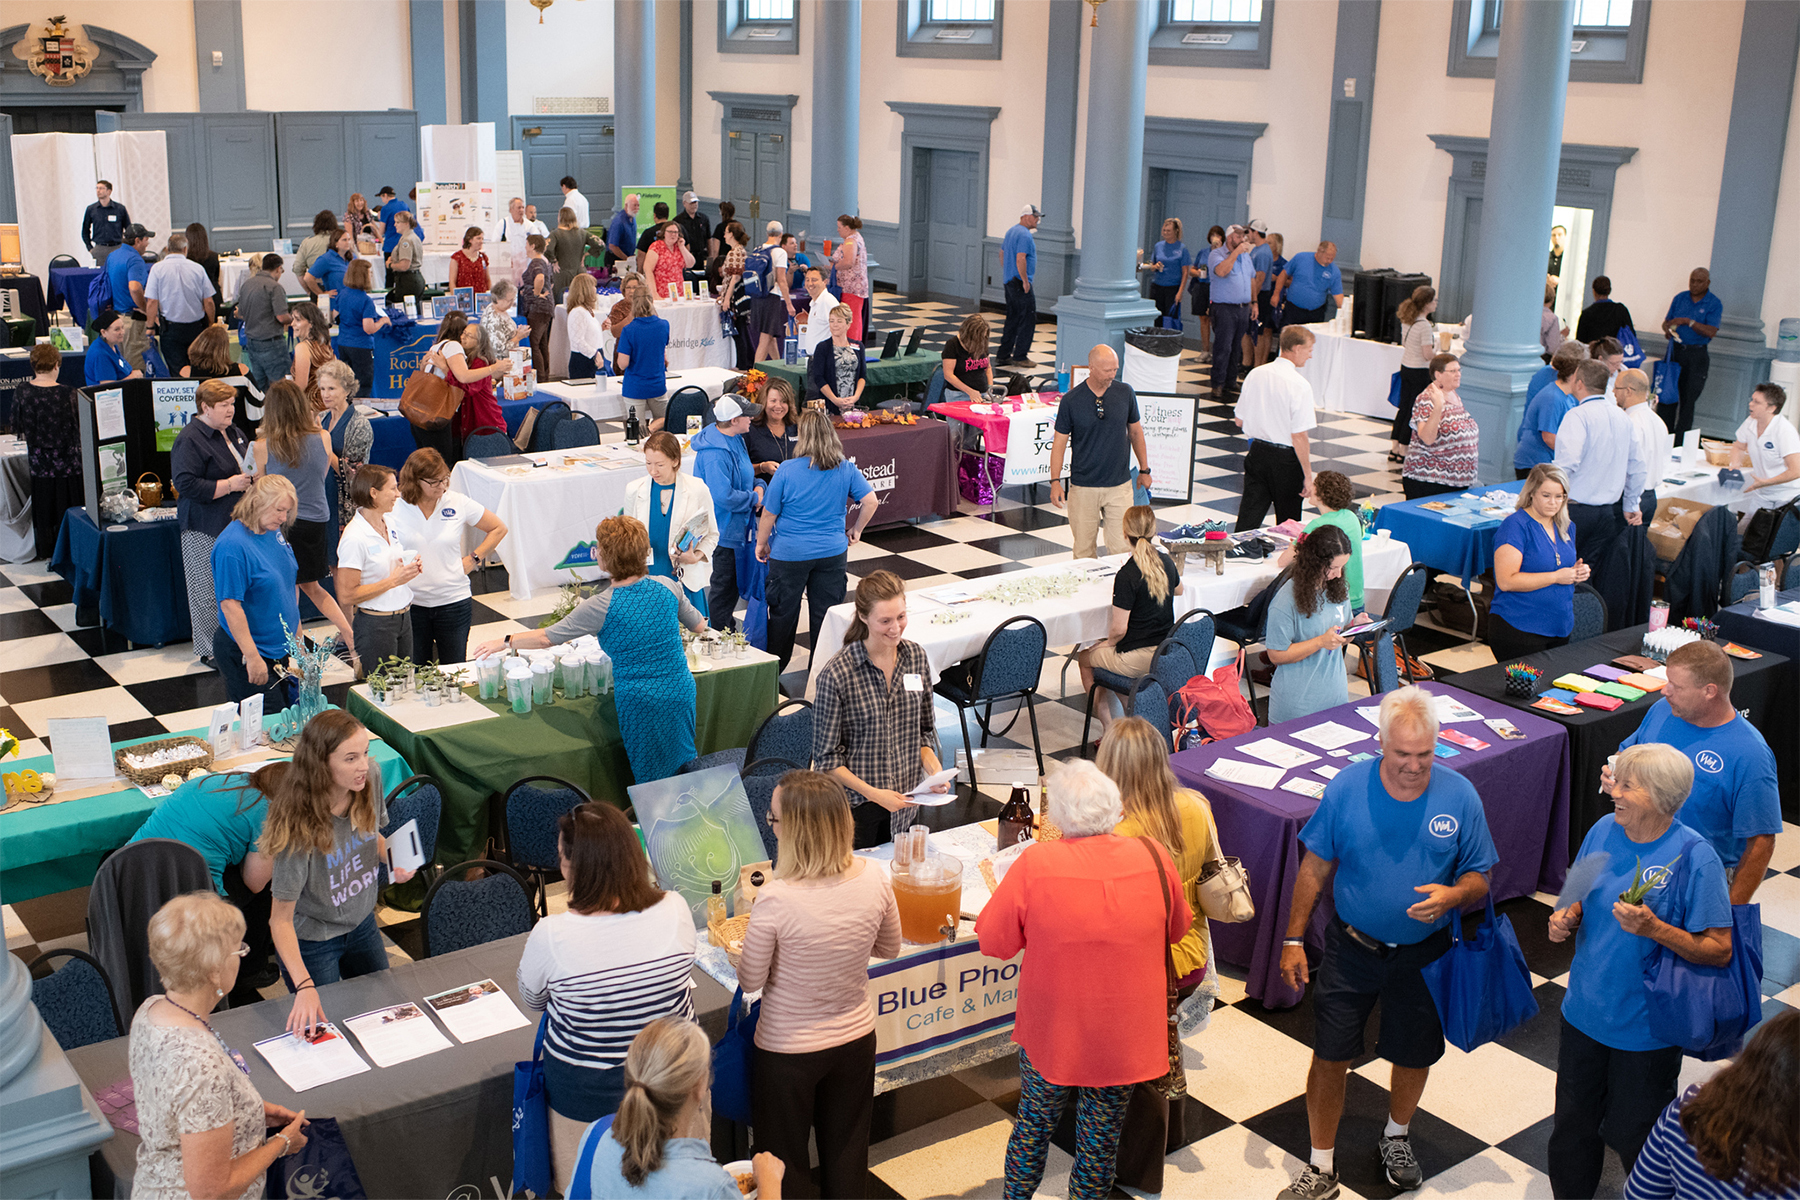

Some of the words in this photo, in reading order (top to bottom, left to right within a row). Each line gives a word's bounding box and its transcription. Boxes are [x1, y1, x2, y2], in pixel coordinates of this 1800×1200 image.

[665, 339, 700, 349] ckbridge
[1144, 415, 1167, 424] your
[872, 480, 893, 489] ARE
[326, 832, 376, 869] MAKE
[330, 854, 364, 890] LIFE
[878, 981, 948, 1016] Blue
[959, 962, 1022, 993] Pho
[906, 1006, 955, 1030] Cafe
[961, 997, 976, 1014] &
